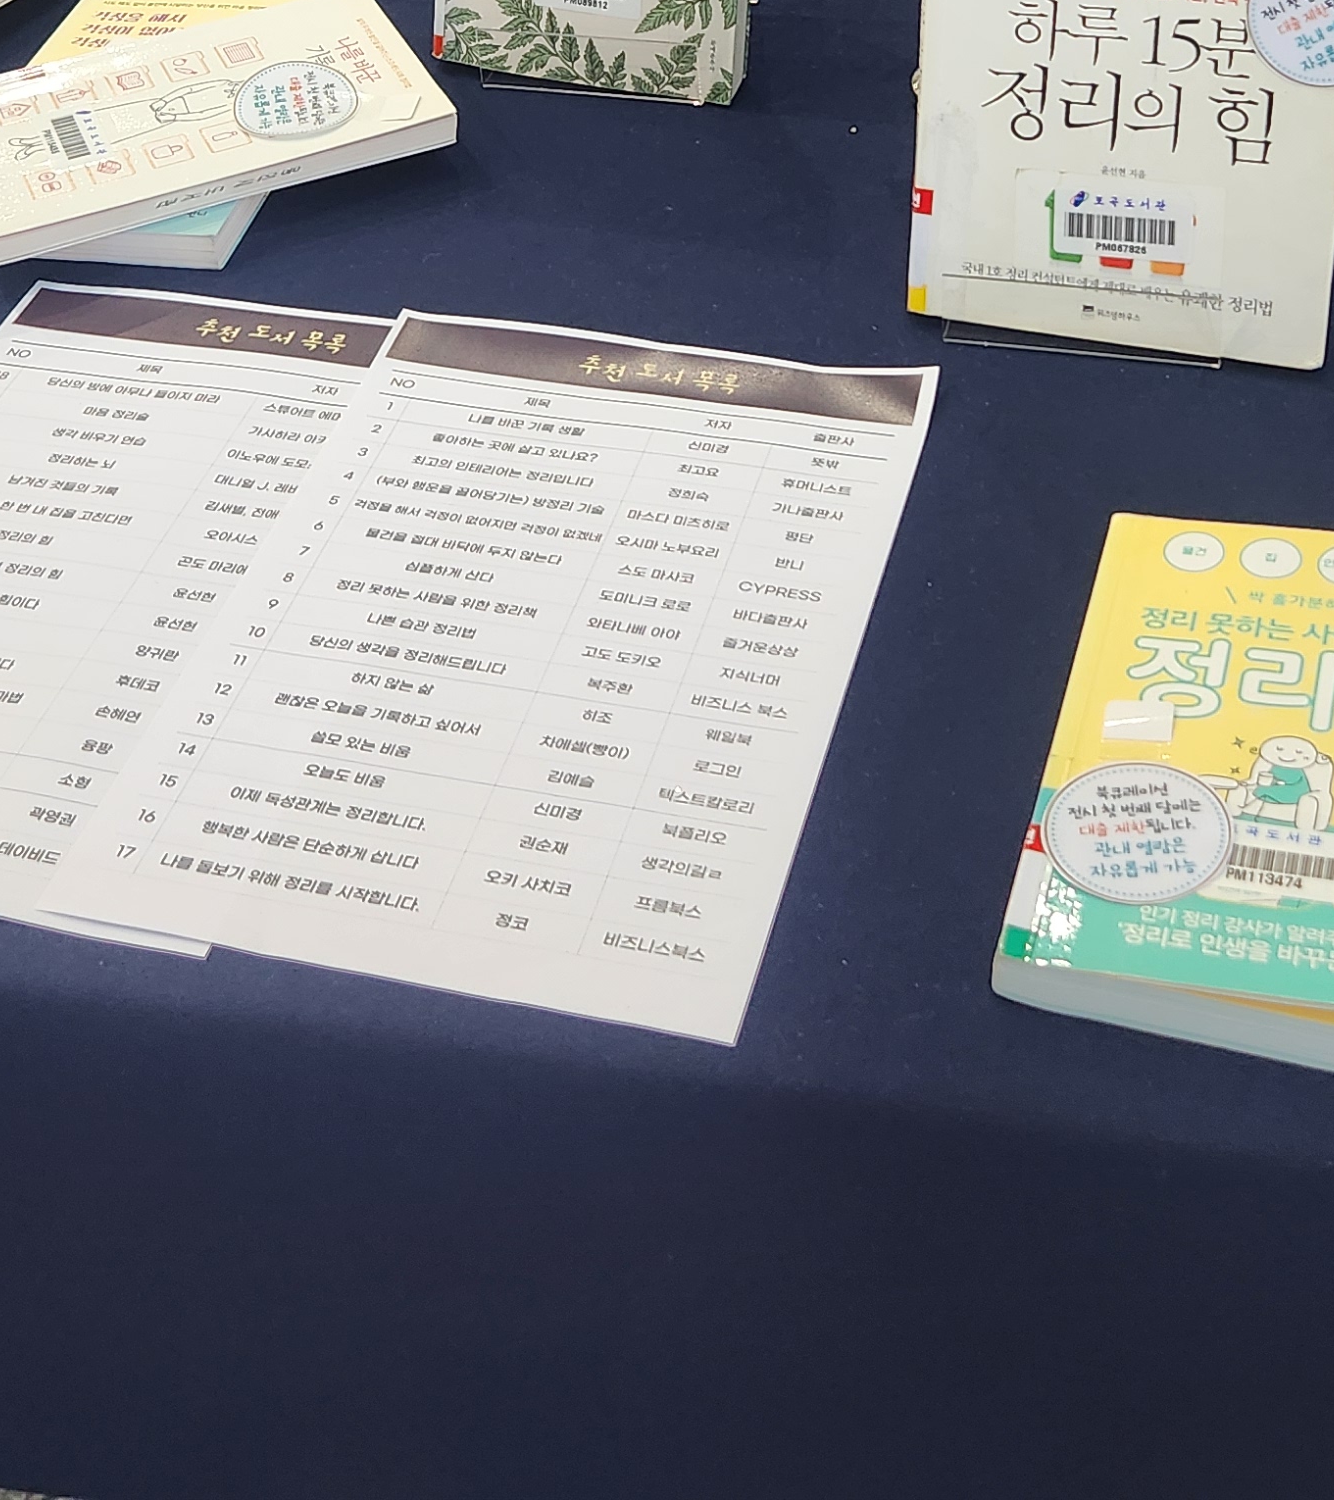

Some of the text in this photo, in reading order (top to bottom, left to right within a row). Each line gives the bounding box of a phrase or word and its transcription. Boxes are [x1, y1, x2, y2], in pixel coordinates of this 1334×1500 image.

[1142, 16, 1254, 78] 15분
[982, 64, 1274, 167] 정리의 힘
[389, 377, 416, 390] NO
[579, 353, 741, 395] 추천 도서 목록
[523, 397, 551, 409] 제목
[704, 418, 732, 432] 저자
[812, 431, 854, 448] 출판사
[676, 463, 720, 480] 최고요
[780, 476, 852, 497] 휴머니스트
[738, 579, 822, 604] CYPRESS
[1141, 606, 1197, 634] 정리
[1206, 610, 1295, 642] 못하는
[351, 670, 435, 696] 하지 않는 삶
[691, 758, 742, 779] 로그인
[1095, 782, 1169, 802] 북큐레이션
[1067, 797, 1202, 821] 전시 첫 번째 달에는
[1079, 816, 1197, 838] 대출 제한됩니다.
[518, 834, 569, 856] 권순재
[1095, 836, 1187, 860] 관내 열람은
[1089, 858, 1197, 880] 자유롭게 가능
[1225, 867, 1303, 890] PM113474
[633, 894, 702, 921] 프롬북스
[1139, 904, 1179, 924] 인기
[1183, 906, 1219, 930] 정리
[1223, 910, 1281, 940] 강사가
[603, 930, 707, 965] 비즈니스북스
[1119, 921, 1192, 950] '정리로
[1199, 931, 1271, 962] 인생을
